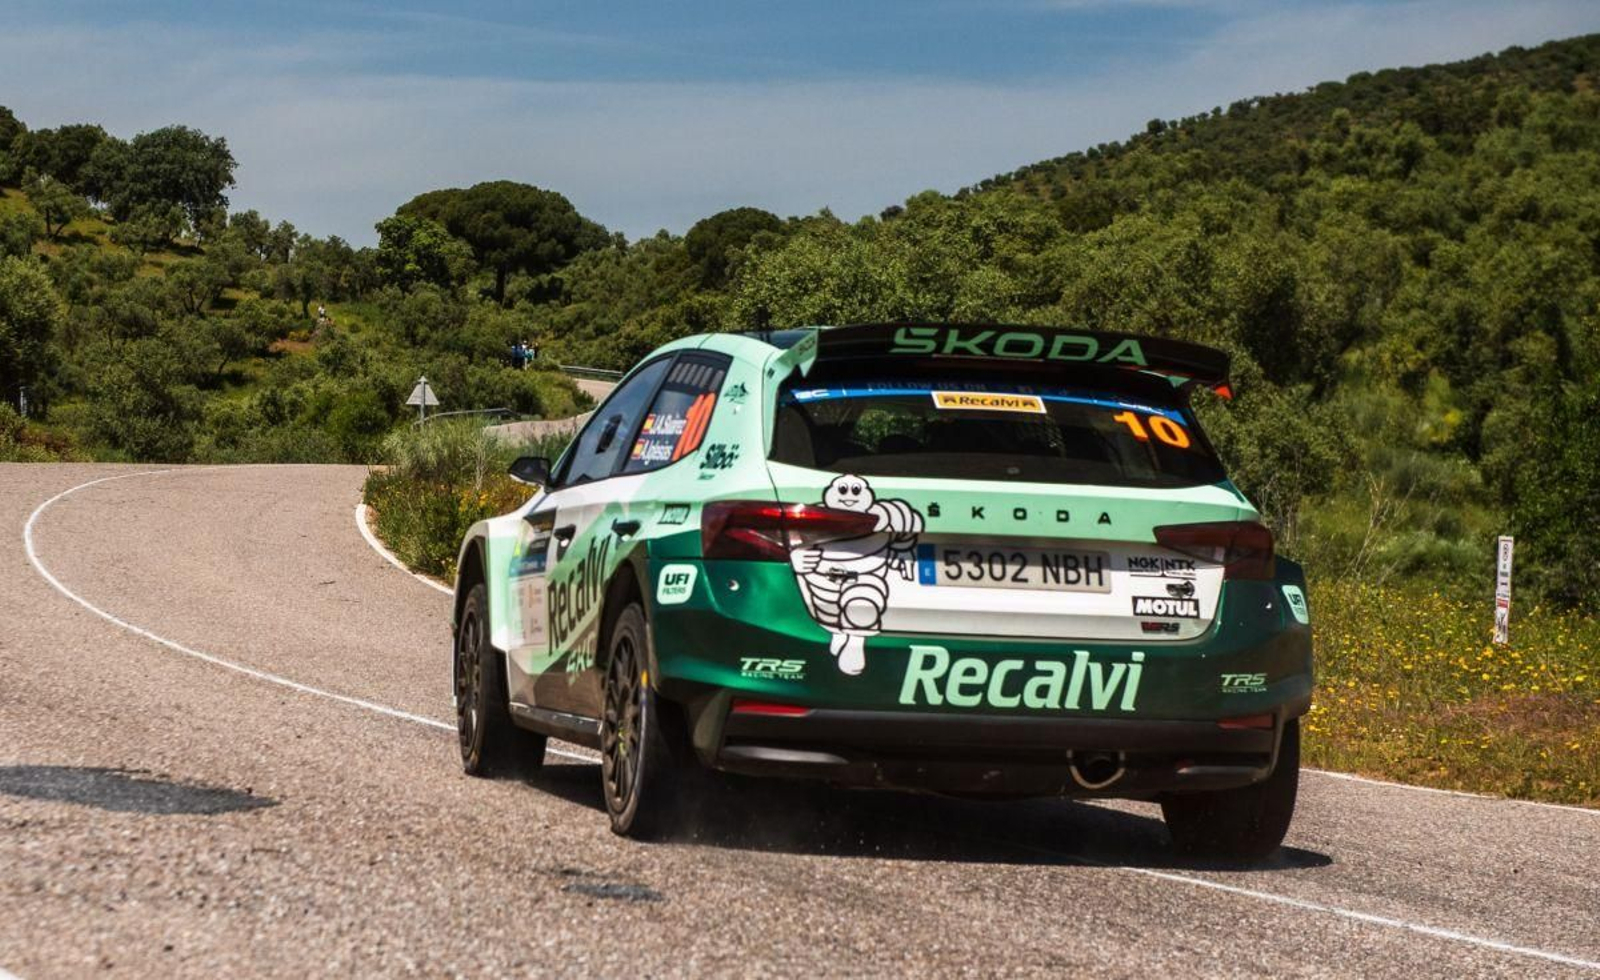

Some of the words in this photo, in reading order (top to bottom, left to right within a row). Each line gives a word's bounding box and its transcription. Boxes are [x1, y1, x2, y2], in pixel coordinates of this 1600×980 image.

[959, 396, 1019, 407] Recalvi
[672, 392, 717, 461] 10
[1113, 411, 1191, 449] 10
[665, 573, 690, 586] UFI
[943, 549, 1030, 585] 5302
[1042, 553, 1104, 587] NBH
[547, 533, 613, 656] Recalvi
[1135, 599, 1198, 617] MOTUL
[740, 657, 806, 673] TRS
[899, 644, 1146, 712] Recalvi
[1221, 673, 1267, 686] TRS
